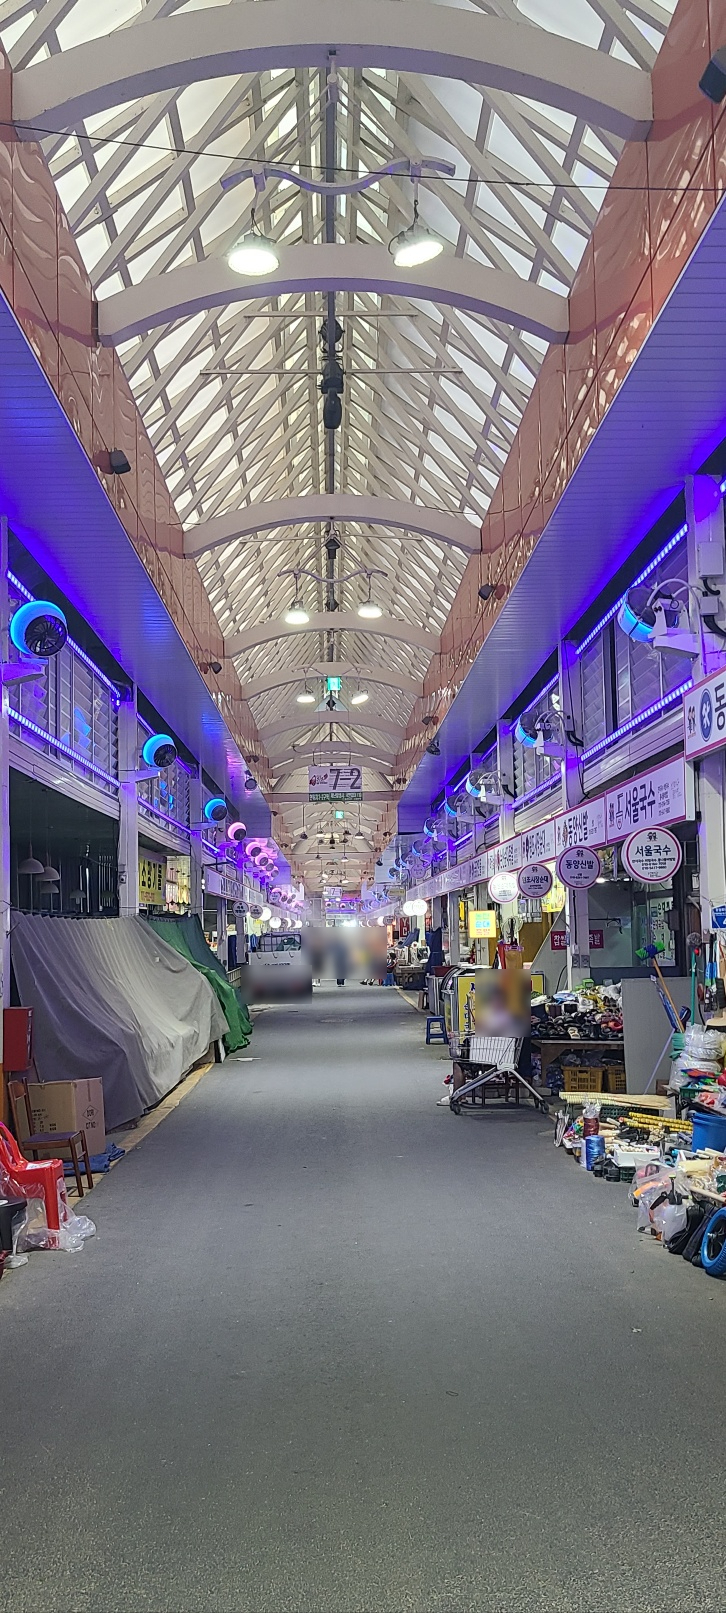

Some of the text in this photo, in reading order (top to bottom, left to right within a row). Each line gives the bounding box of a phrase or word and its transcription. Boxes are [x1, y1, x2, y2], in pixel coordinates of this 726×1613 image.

[329, 767, 361, 790] 7-2
[625, 781, 656, 825] 서울국수
[568, 810, 588, 847] 동양신발
[635, 844, 671, 856] 서울국수
[565, 860, 594, 869] 동양신발
